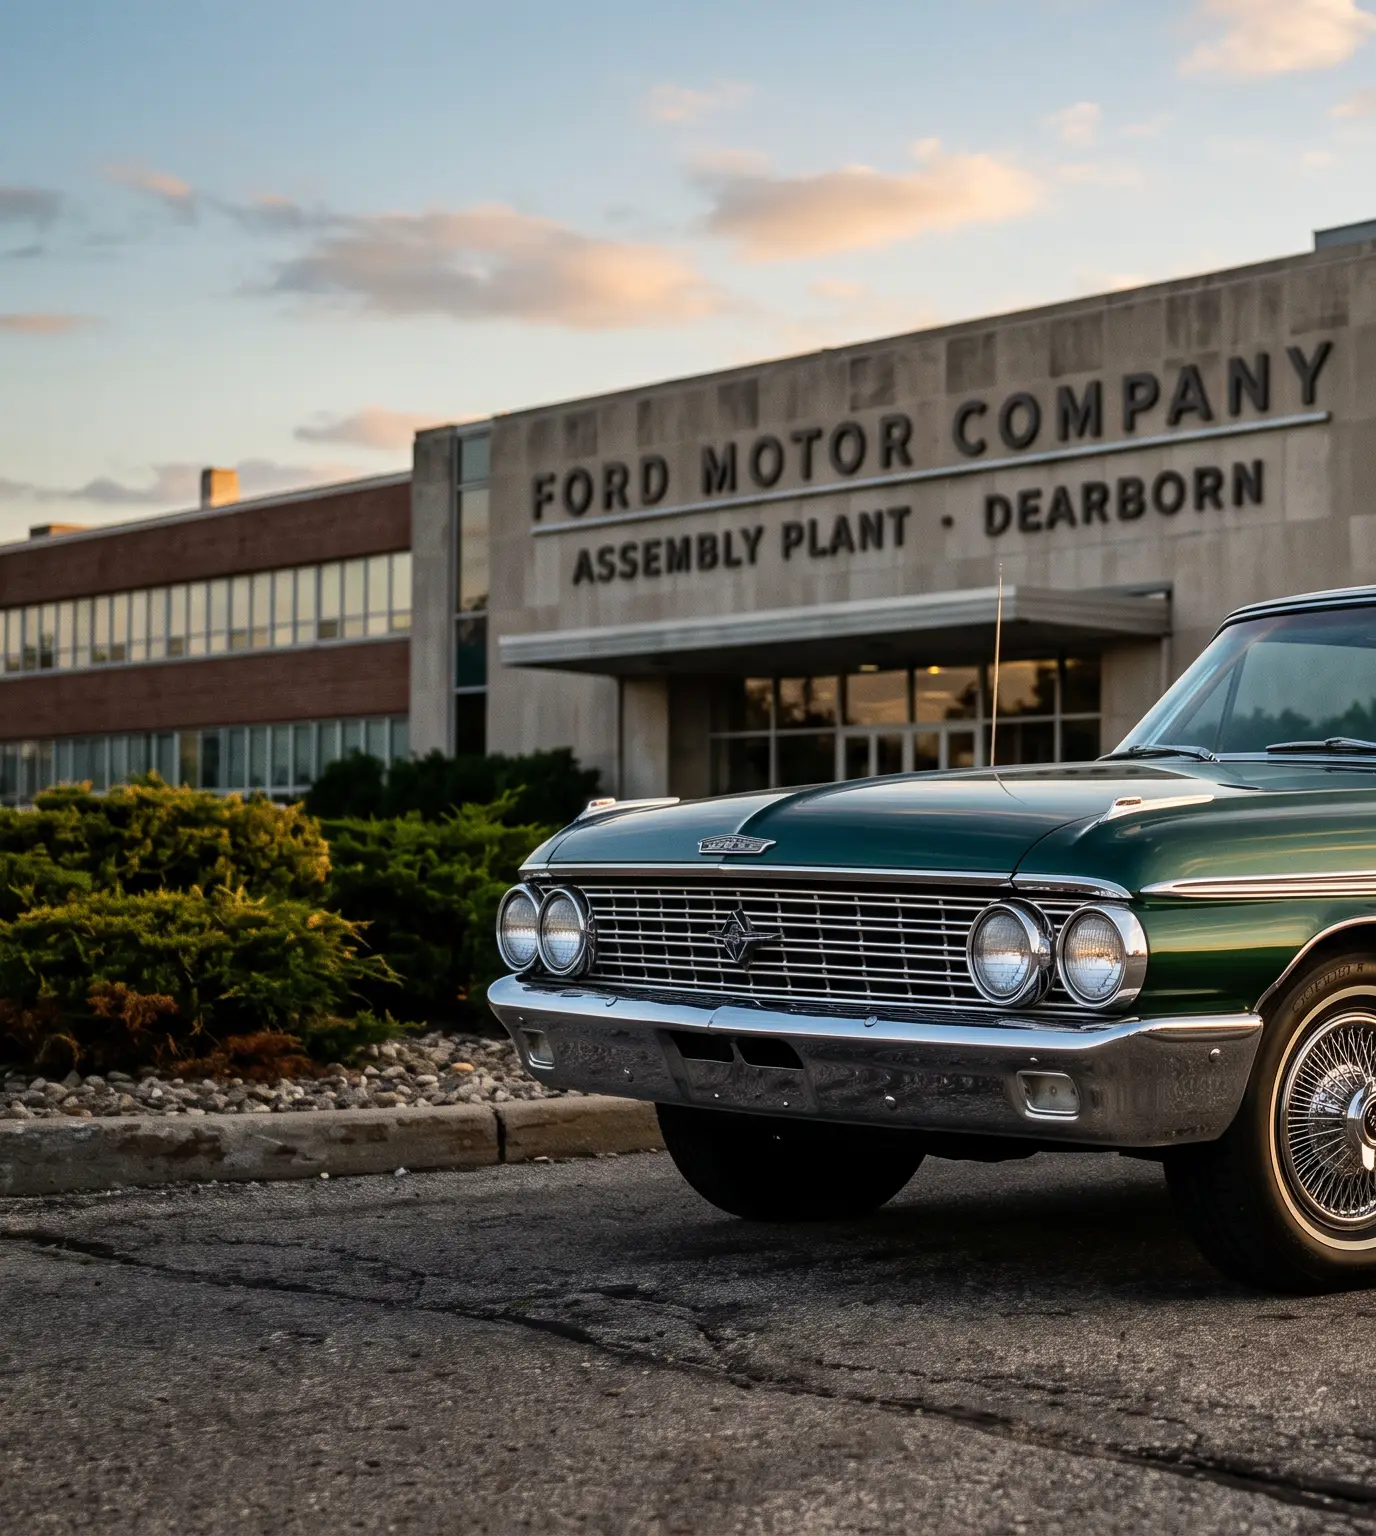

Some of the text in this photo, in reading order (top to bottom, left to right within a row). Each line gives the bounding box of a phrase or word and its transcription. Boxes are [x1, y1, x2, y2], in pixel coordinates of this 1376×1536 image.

[531, 340, 1334, 521] FORD MOTOR COMPANY
[572, 525, 765, 586] ASSEMBLY
[781, 505, 912, 562] PLANT
[983, 459, 1265, 537] DEARBORN
